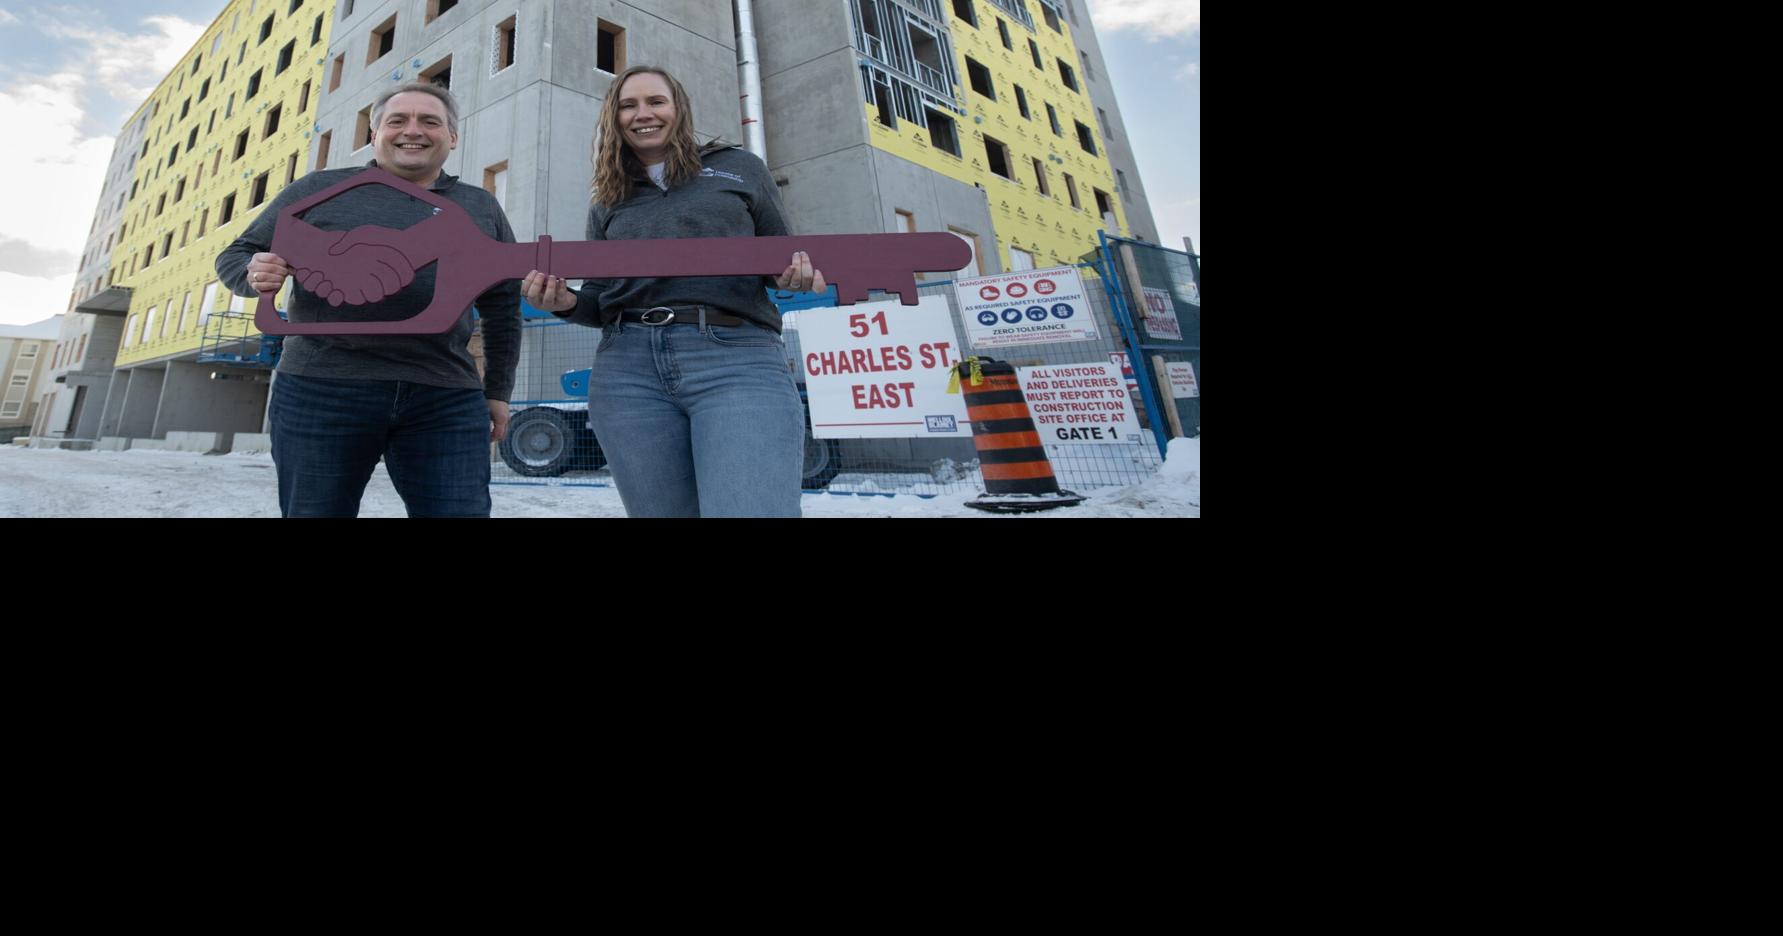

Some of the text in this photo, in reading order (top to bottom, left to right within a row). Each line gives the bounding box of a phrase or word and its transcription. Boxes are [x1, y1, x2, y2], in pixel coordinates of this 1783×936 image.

[959, 269, 1072, 287] MANDATORY SAFETY EQUIPMENT
[974, 302, 1009, 310] REQUIRED
[1037, 294, 1081, 303] EQUIPMENT
[849, 311, 889, 338] 51
[993, 323, 1066, 336] ZERO TOLERANCE
[806, 345, 913, 376] CHARLES
[1031, 366, 1106, 379] ALL VISITORS
[1026, 381, 1049, 390] AND
[1051, 377, 1119, 389] DELIVERIES
[851, 381, 916, 410] EAST
[1026, 389, 1125, 401] MUST REPORT TO
[1034, 401, 1125, 413] CONSTRUCTION
[1038, 413, 1126, 424] SITE OFFICE AT
[1056, 427, 1103, 441] GATE
[1108, 426, 1118, 439] 1
